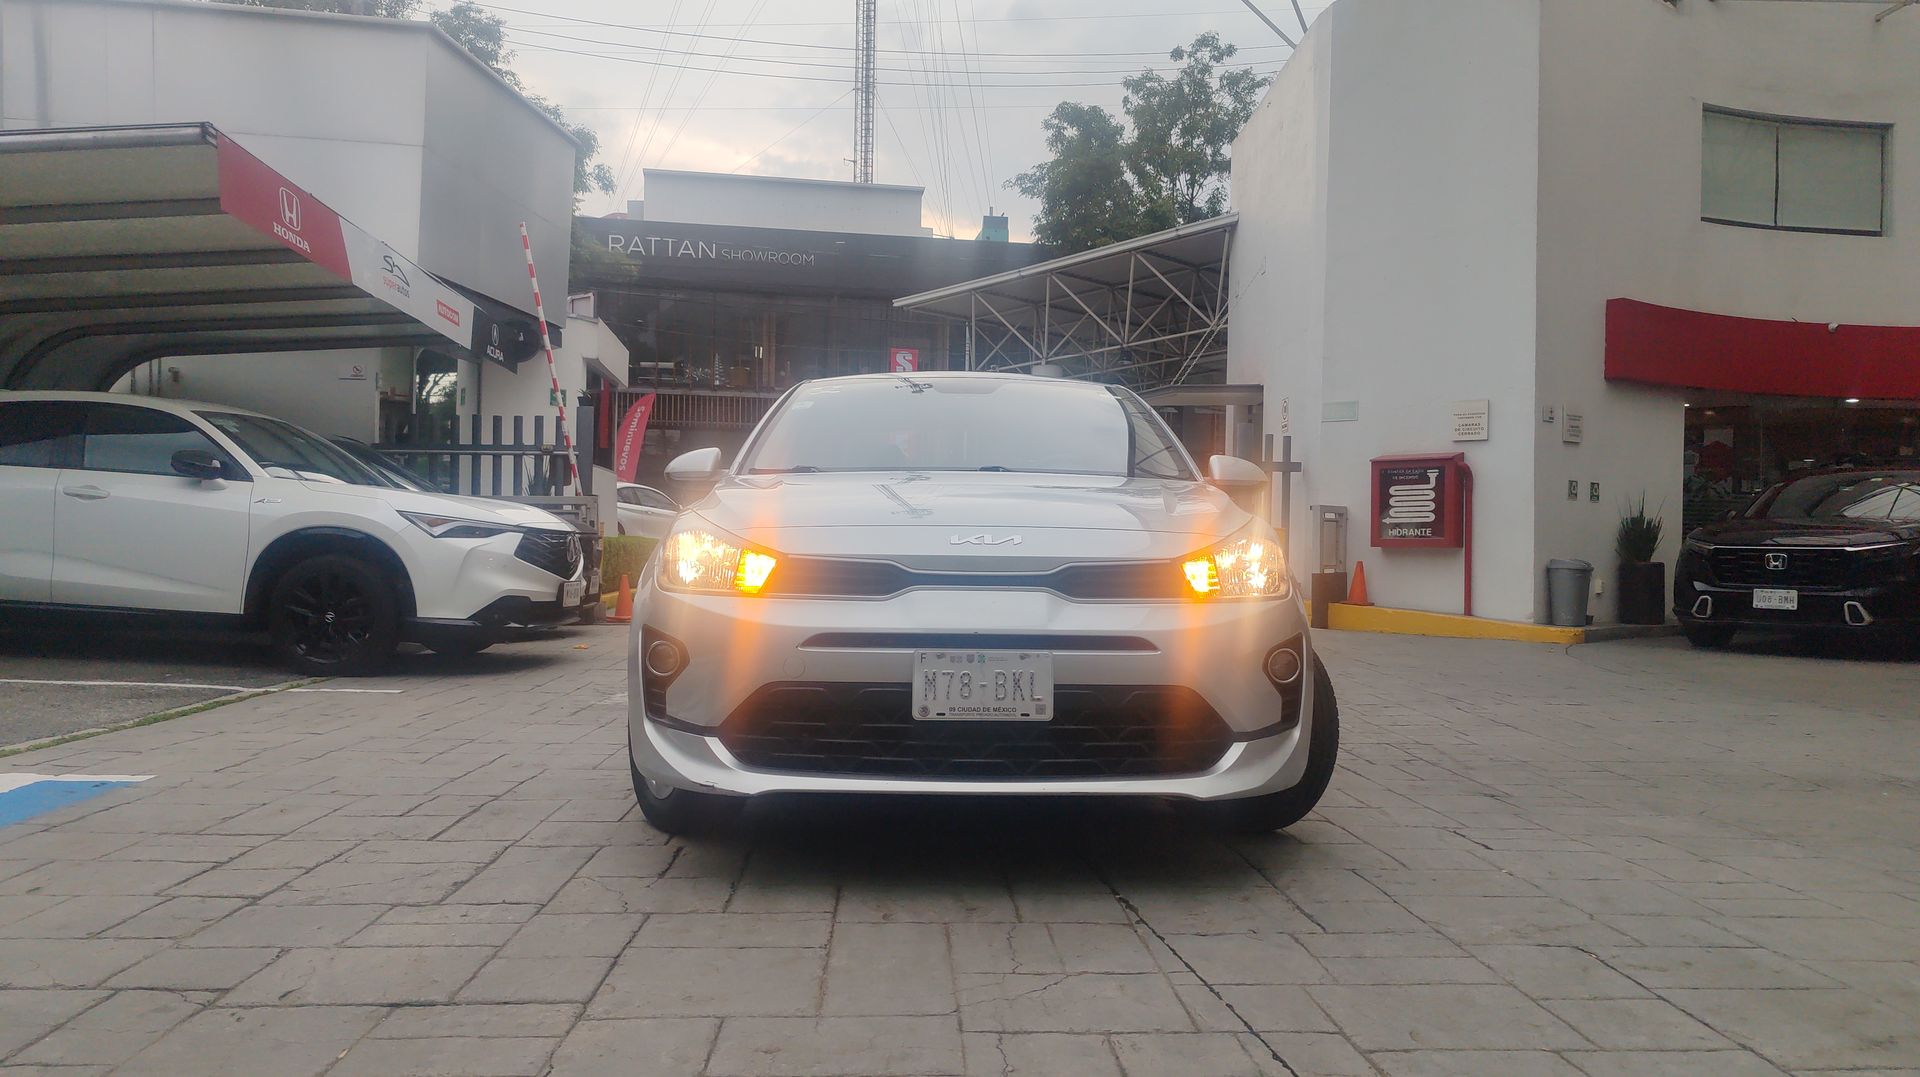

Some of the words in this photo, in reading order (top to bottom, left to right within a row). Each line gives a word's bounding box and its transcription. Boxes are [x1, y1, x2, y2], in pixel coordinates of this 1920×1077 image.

[273, 222, 311, 253] HONDA
[608, 235, 716, 259] RATTAN
[721, 248, 815, 266] SHOWROOM
[486, 344, 504, 362] ACURA
[950, 534, 1023, 545] KIA
[1388, 528, 1432, 536] HIDRANTE
[923, 669, 1044, 701] M78-BKL
